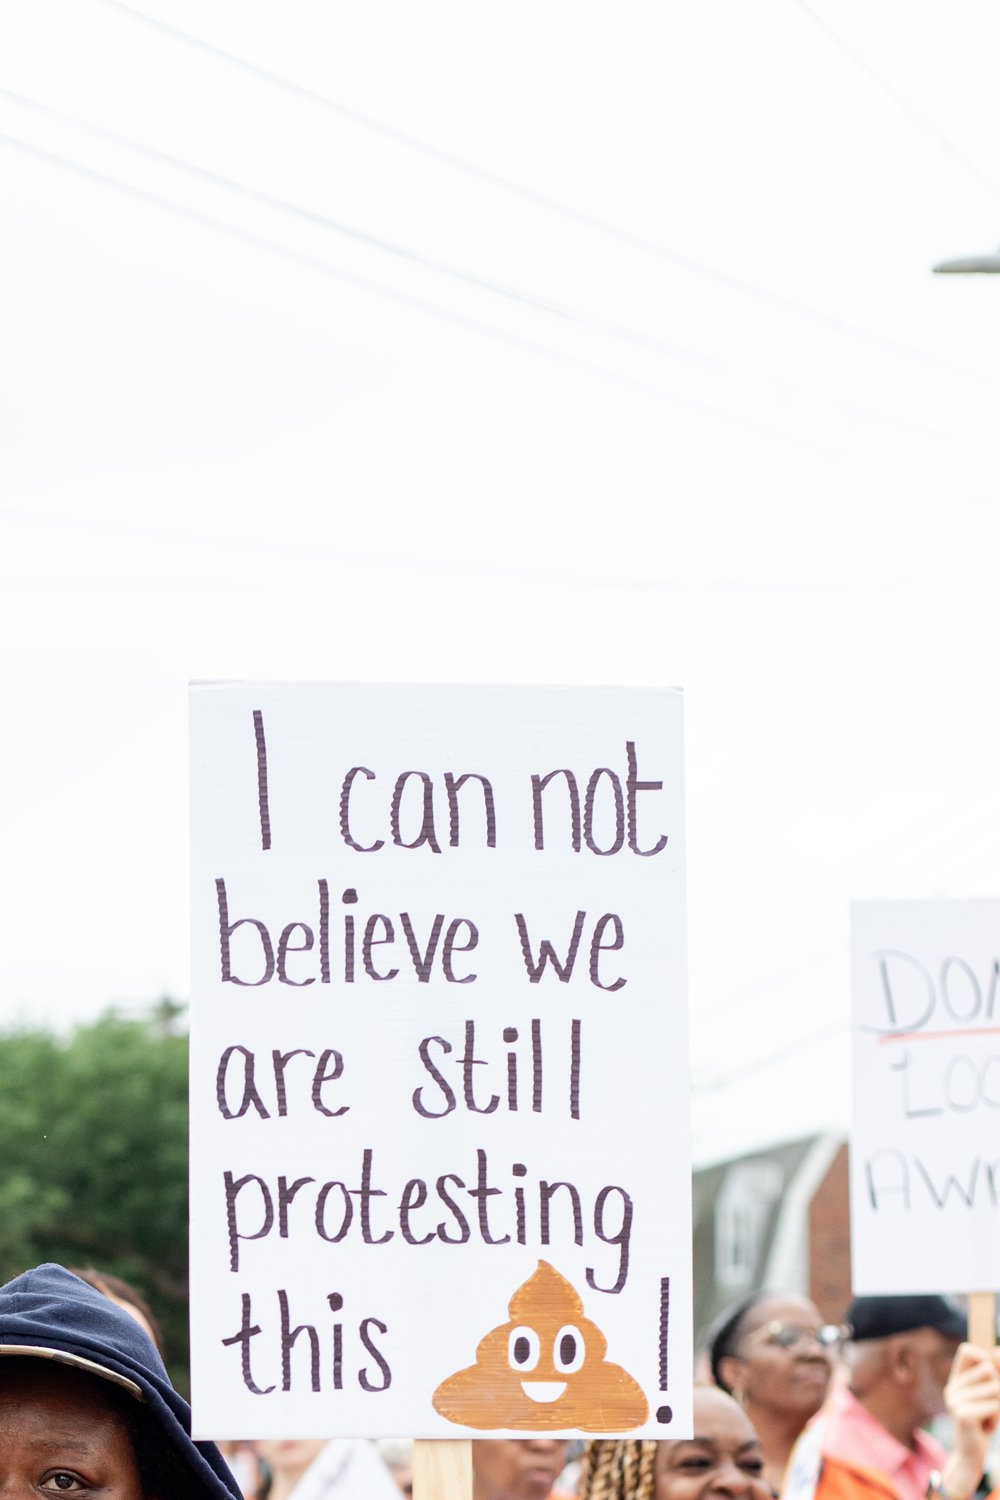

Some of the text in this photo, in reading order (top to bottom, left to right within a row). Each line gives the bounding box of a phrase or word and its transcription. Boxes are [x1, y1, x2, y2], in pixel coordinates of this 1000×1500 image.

[252, 709, 669, 857] I can not
[214, 877, 628, 992] believe we
[216, 1018, 583, 1122] are still
[222, 1148, 636, 1295] protesting
[221, 1289, 393, 1395] this
